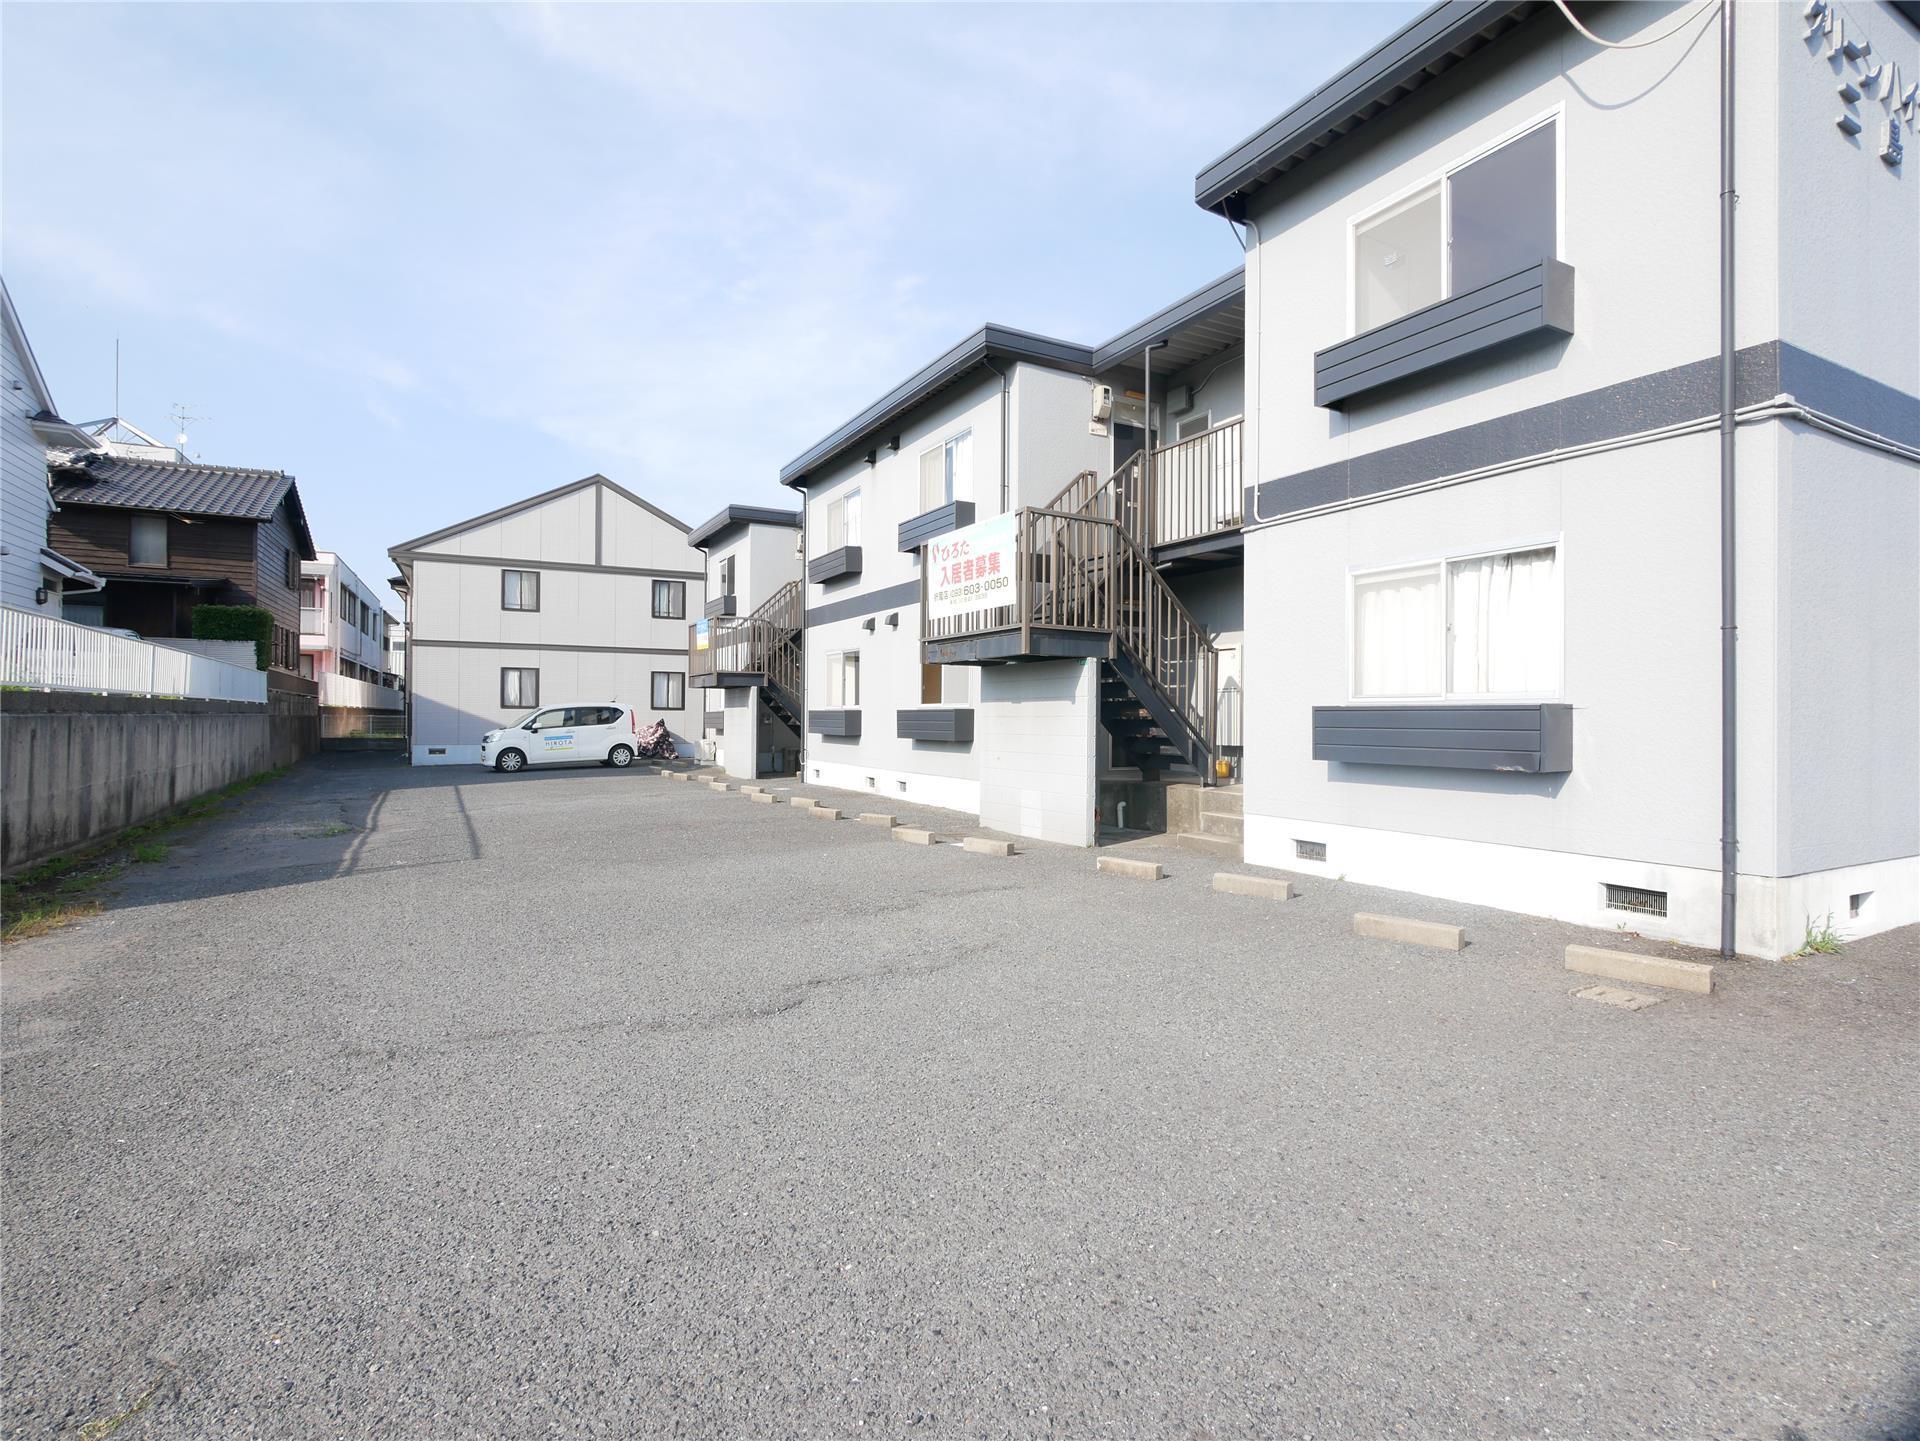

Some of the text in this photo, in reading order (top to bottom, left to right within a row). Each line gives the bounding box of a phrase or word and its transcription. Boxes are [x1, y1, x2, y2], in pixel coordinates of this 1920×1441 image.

[1803, 0, 1920, 125] グリーンハイ
[940, 552, 1001, 587] 入居者募集
